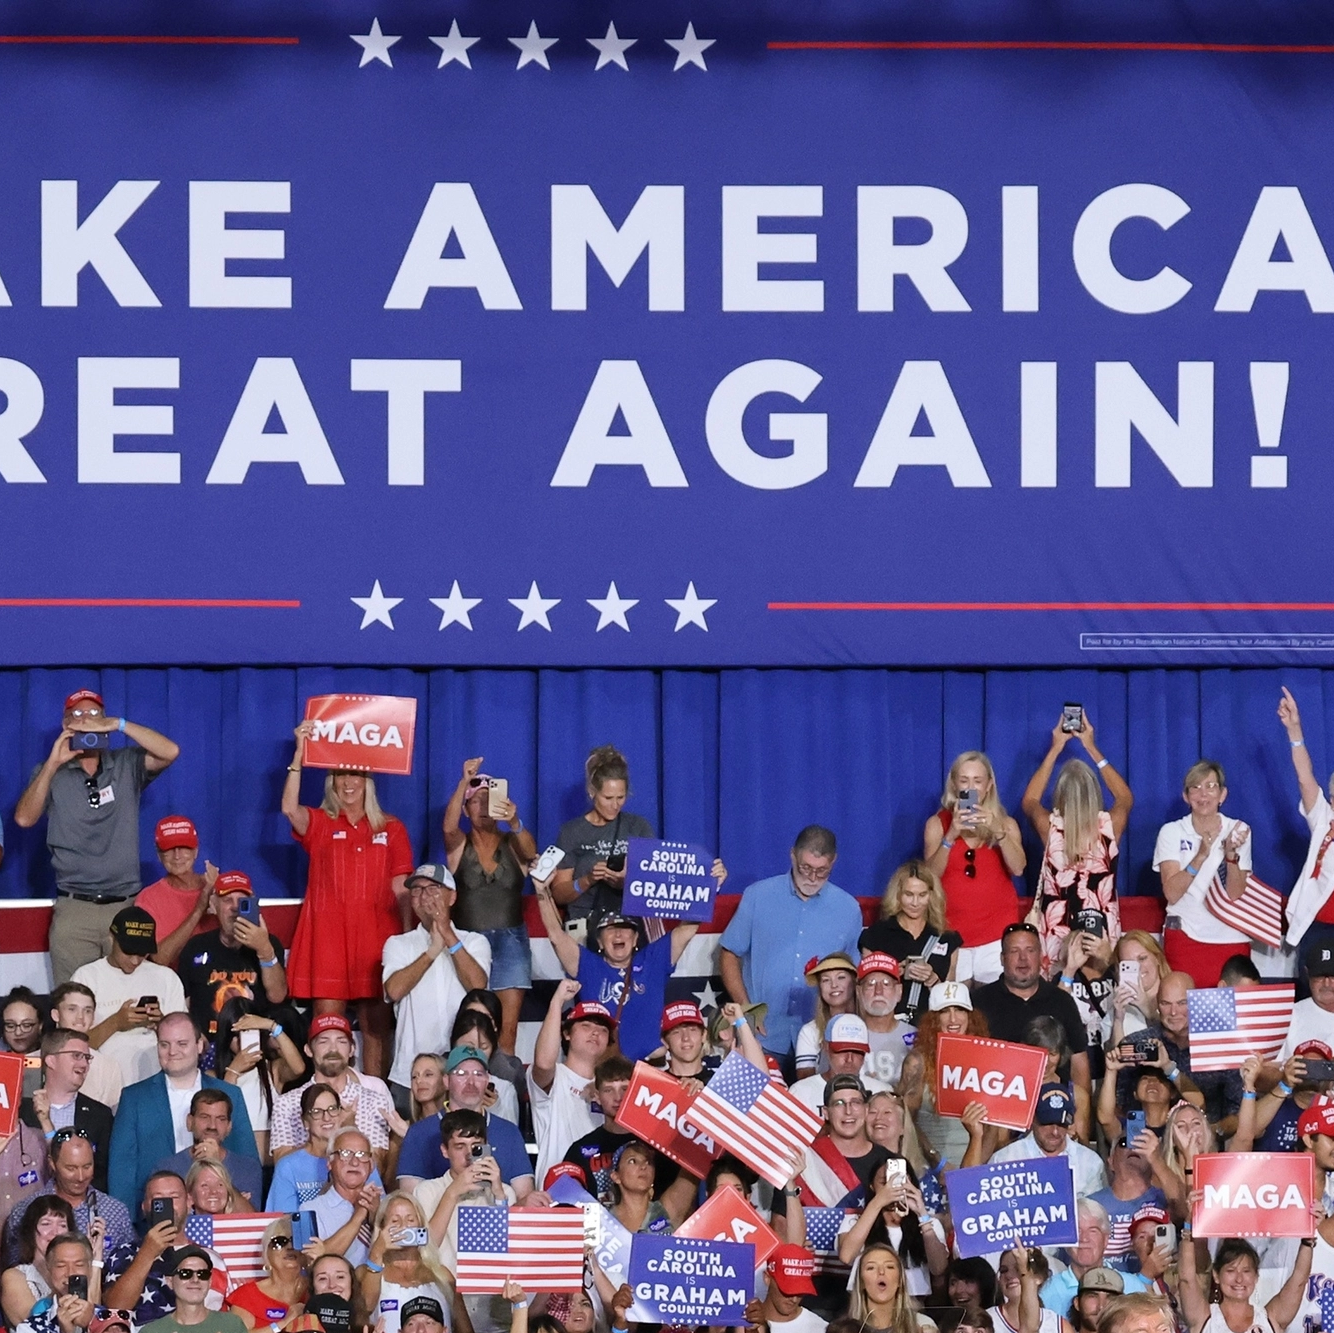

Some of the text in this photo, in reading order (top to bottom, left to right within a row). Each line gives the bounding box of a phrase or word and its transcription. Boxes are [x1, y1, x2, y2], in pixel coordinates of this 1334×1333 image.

[551, 360, 1290, 490] AGAIN!
[313, 721, 404, 749] MAGA
[652, 850, 696, 865] SOUTH
[640, 860, 706, 877] CAROLINA
[667, 874, 676, 883] IS
[629, 880, 710, 903] GRAHAM
[646, 898, 692, 911] COUNTRY
[944, 983, 958, 1000] 47
[942, 1065, 1028, 1101] MAGA
[634, 1085, 716, 1154] MAGA
[979, 1172, 1039, 1192] SOUTH
[967, 1181, 1055, 1205] CAROLINA
[1204, 1183, 1306, 1210] MAGA
[1007, 1198, 1018, 1208] IS
[962, 1205, 1068, 1234] GRAHAM
[987, 1226, 1047, 1242] COUNTRY
[663, 1249, 721, 1265] SOUTH
[647, 1259, 736, 1278] CAROLINA
[685, 1276, 696, 1285] IS
[636, 1283, 746, 1305] GRAHAM
[658, 1303, 722, 1317] COUNTRY
